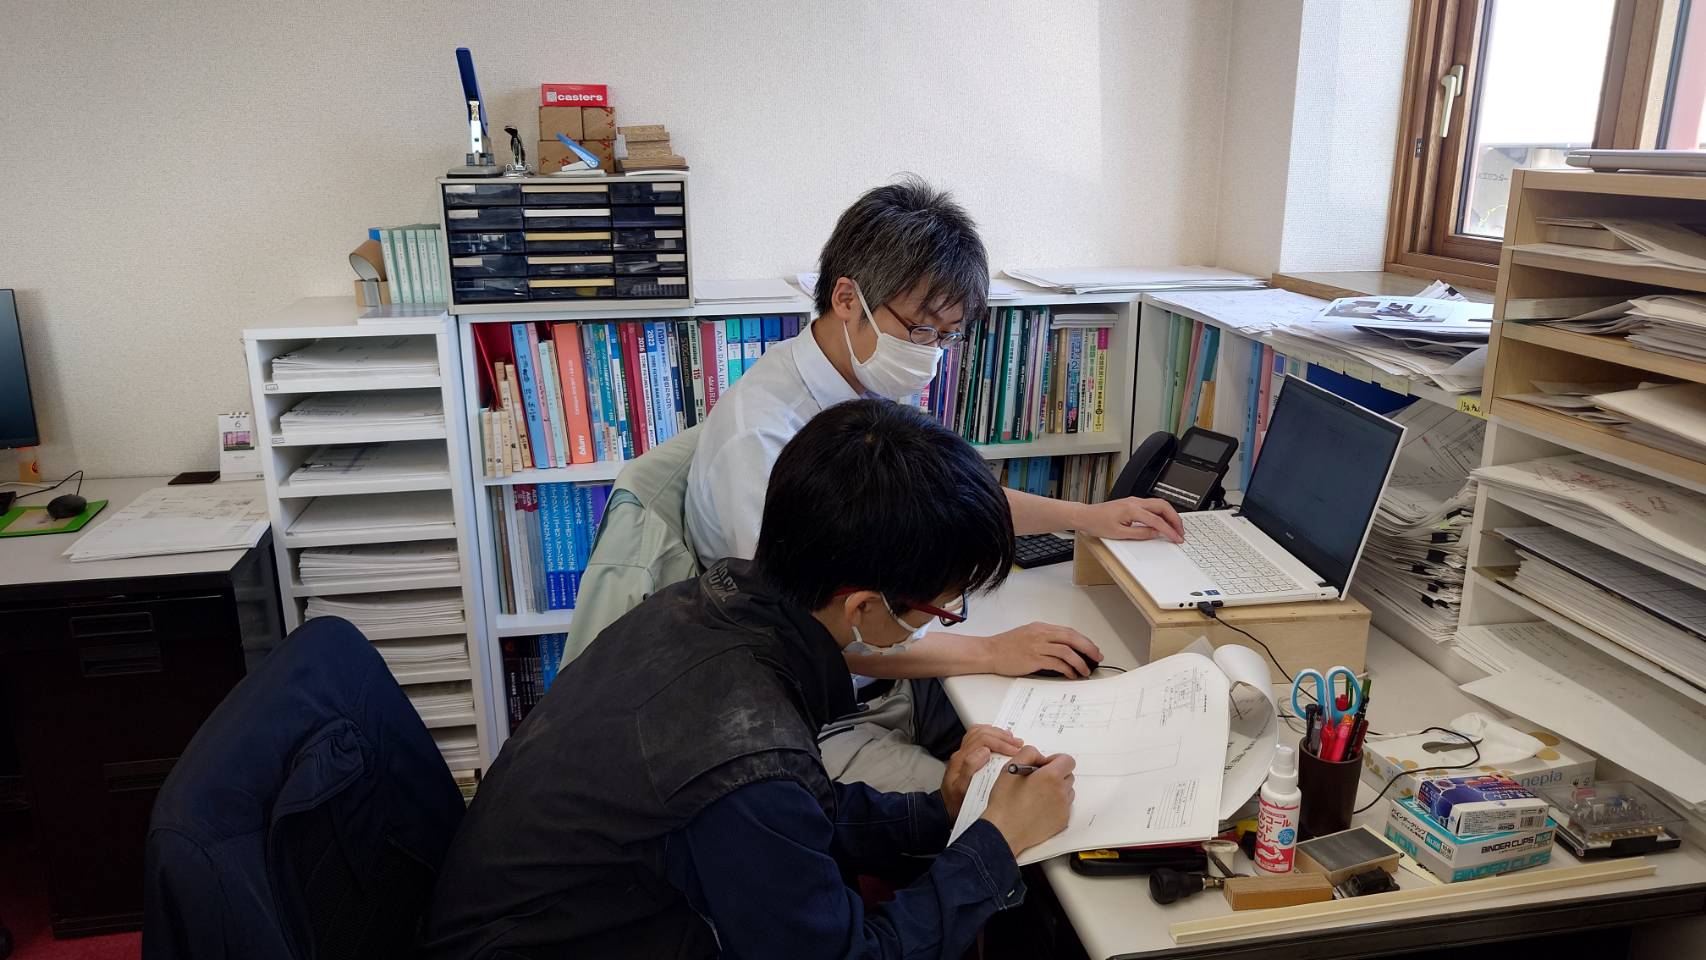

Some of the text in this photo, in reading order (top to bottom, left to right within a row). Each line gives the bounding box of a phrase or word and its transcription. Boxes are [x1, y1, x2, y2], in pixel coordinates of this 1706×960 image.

[557, 93, 603, 101] casters
[1520, 769, 1563, 787] nepia
[1385, 822, 1418, 859] LION
[1481, 841, 1512, 854] BINDER
[1511, 836, 1534, 849] CLIPS
[1453, 851, 1551, 883] BINDER CLIPS
